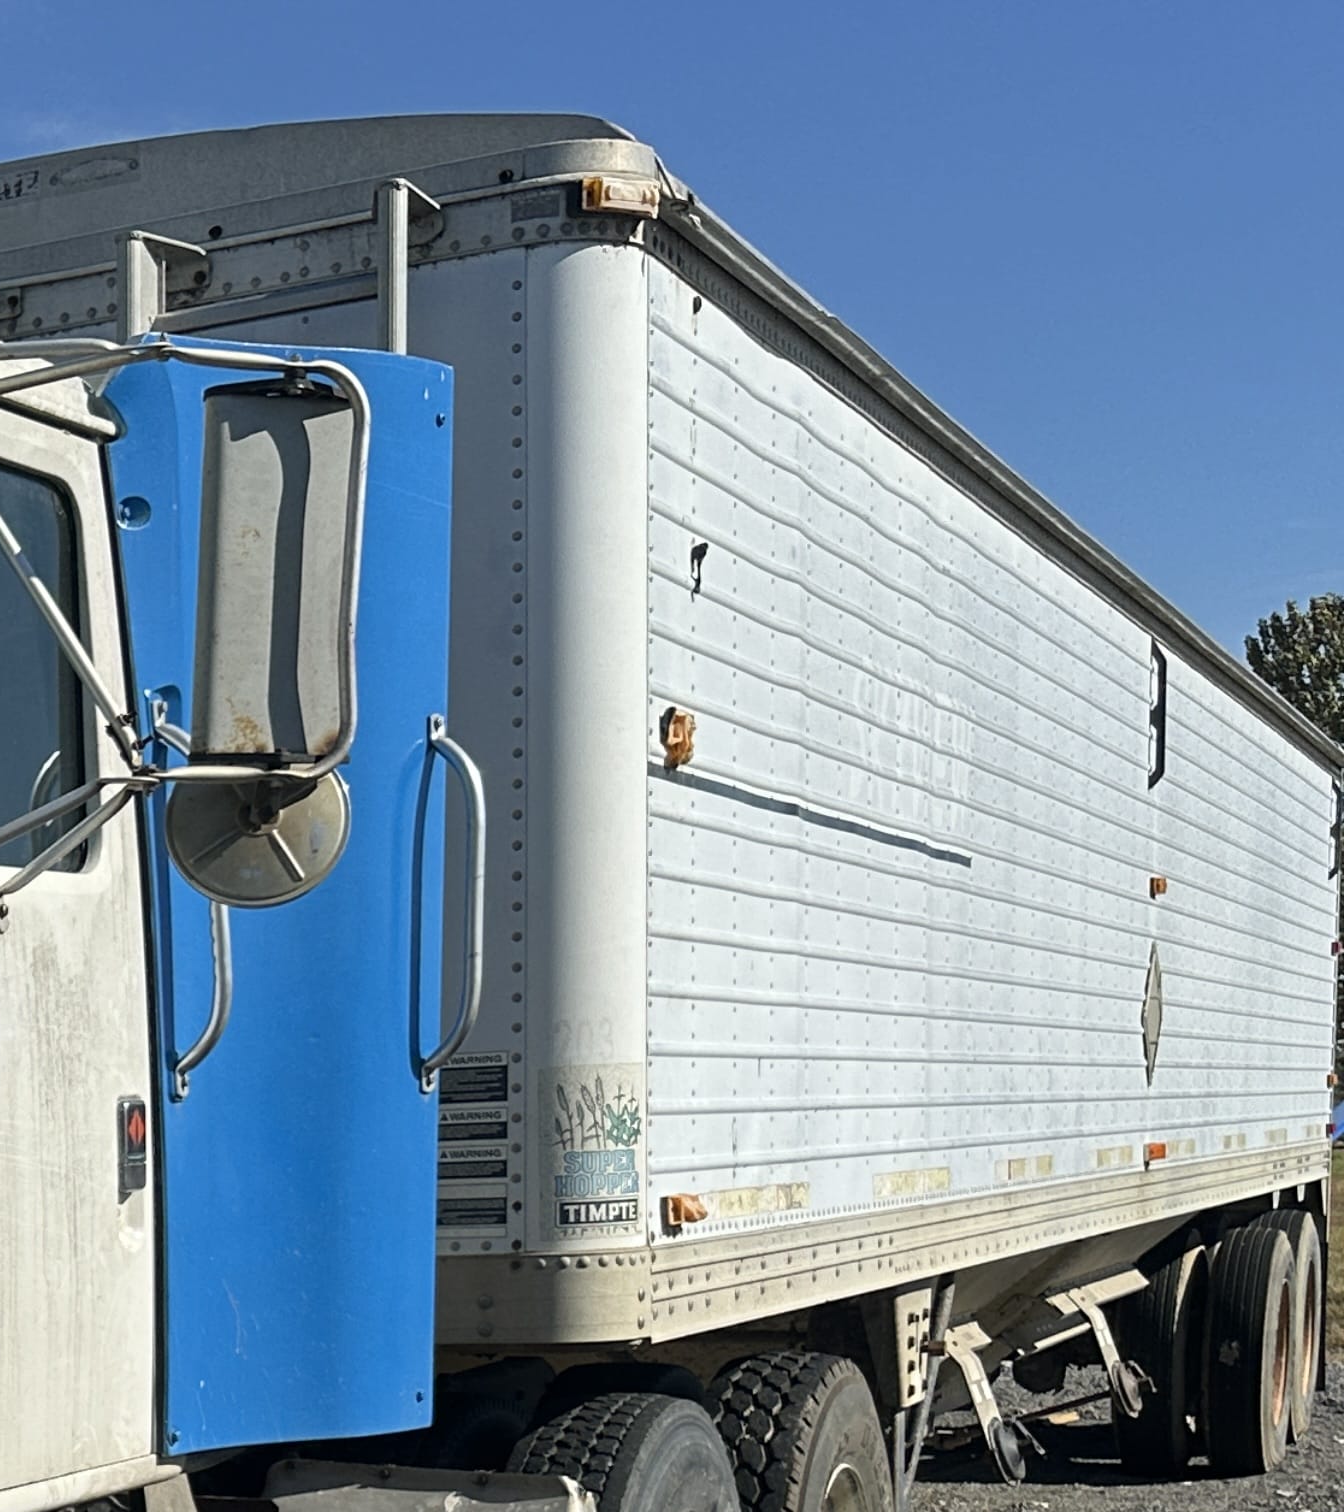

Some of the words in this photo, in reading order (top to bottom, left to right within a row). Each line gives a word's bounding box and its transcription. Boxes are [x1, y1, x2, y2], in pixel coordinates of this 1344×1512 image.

[450, 1052, 502, 1065] WARNING
[449, 1110, 502, 1121] WARNING
[448, 1148, 502, 1160] WARNING
[563, 1202, 637, 1223] TIMPTE
